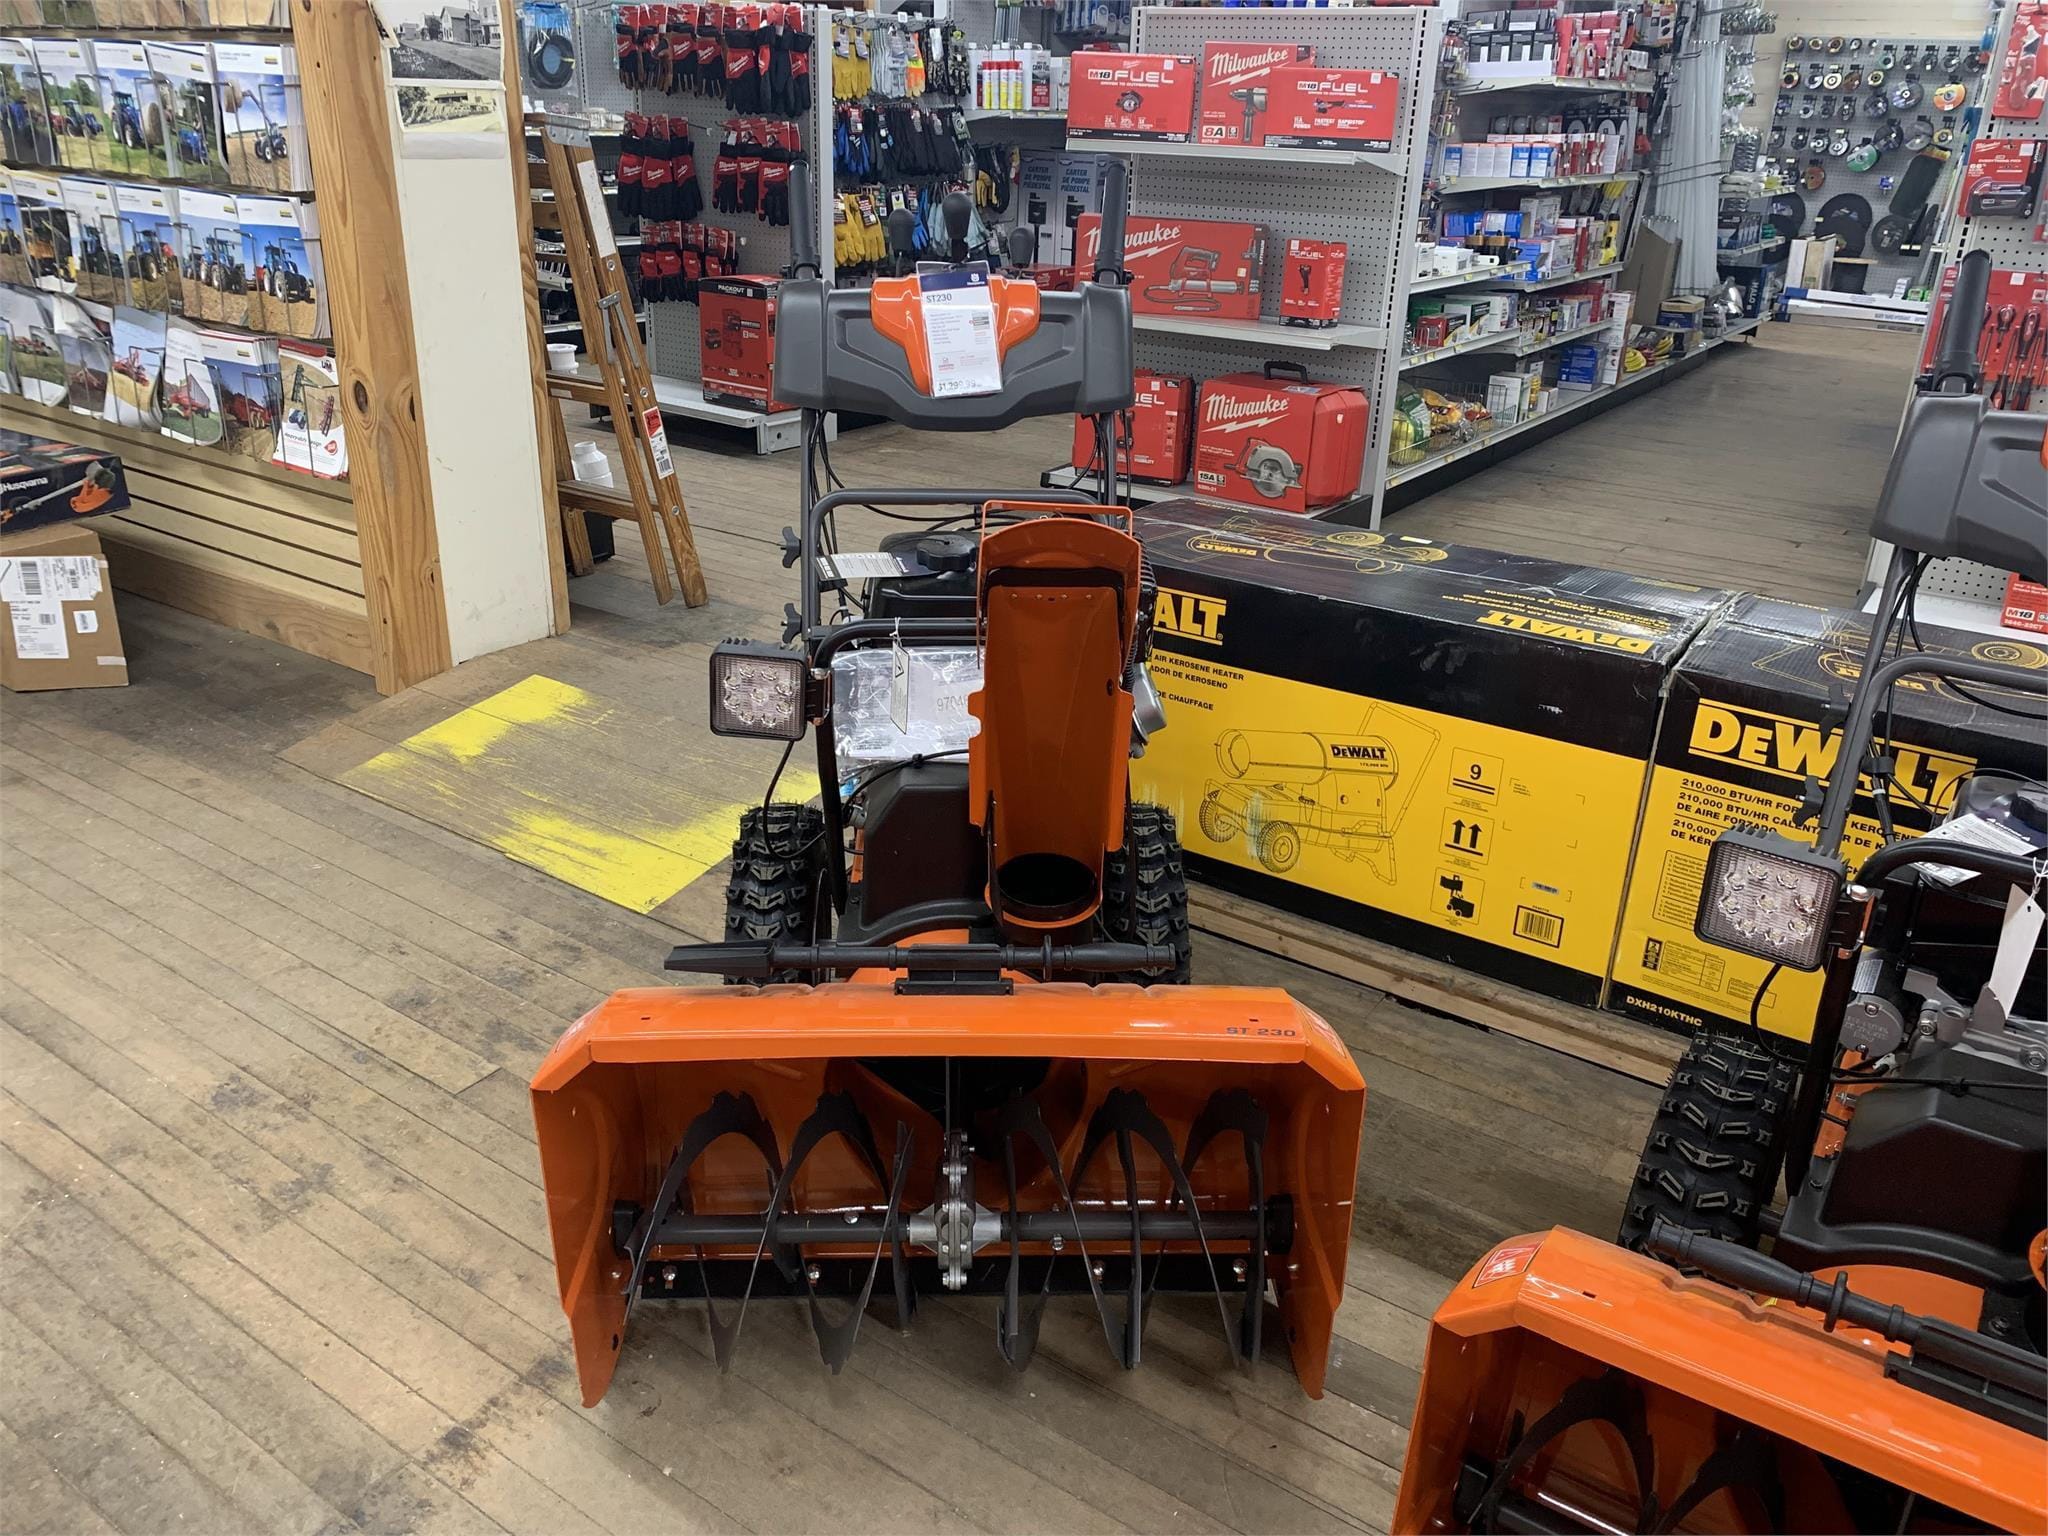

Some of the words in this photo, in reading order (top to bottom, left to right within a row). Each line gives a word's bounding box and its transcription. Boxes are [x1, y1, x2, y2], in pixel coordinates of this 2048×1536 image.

[1208, 47, 1289, 78] Milwaukee
[1088, 69, 1112, 80] M18
[1115, 70, 1174, 84] FUEL
[1319, 81, 1368, 93] FUEL
[1203, 126, 1224, 138] 8A
[1083, 223, 1181, 258] Mwaukee
[926, 293, 952, 303] ST230
[1135, 393, 1165, 405] EL
[1202, 393, 1289, 424] Milwaukee
[3, 476, 49, 492] Husqvarna
[1199, 472, 1215, 481] 15A
[1153, 591, 1226, 640] ALT
[2007, 608, 2034, 619] M18
[1476, 610, 1655, 654] DEWALT
[1154, 654, 1167, 663] AIR
[1169, 655, 1210, 673] KEROSENE
[1212, 667, 1245, 681] HEATER
[1151, 665, 1171, 675] ADOR
[1172, 670, 1183, 679] DE
[1185, 673, 1228, 689] KEROSENO
[1168, 693, 1214, 711] CHAUFFAGE
[1331, 745, 1386, 759] DEWALT
[1689, 703, 1977, 811] DEWLT
[1469, 764, 1482, 780] 9
[1682, 778, 1726, 796] 210,000
[1729, 790, 1773, 808] BTU/HR
[1676, 803, 1691, 812] DE
[1695, 807, 1720, 820] AIRE
[1679, 792, 1723, 809] 210,000
[1726, 804, 1769, 821] BTU/HR
[1854, 836, 1872, 848] DE
[1673, 819, 1717, 836] 210,000
[1670, 829, 1685, 839] DE
[1689, 832, 1712, 847] KÉR
[1626, 995, 1703, 1027] DXH210KTHC
[1226, 1027, 1249, 1035] ST
[1257, 1028, 1296, 1037] 230
